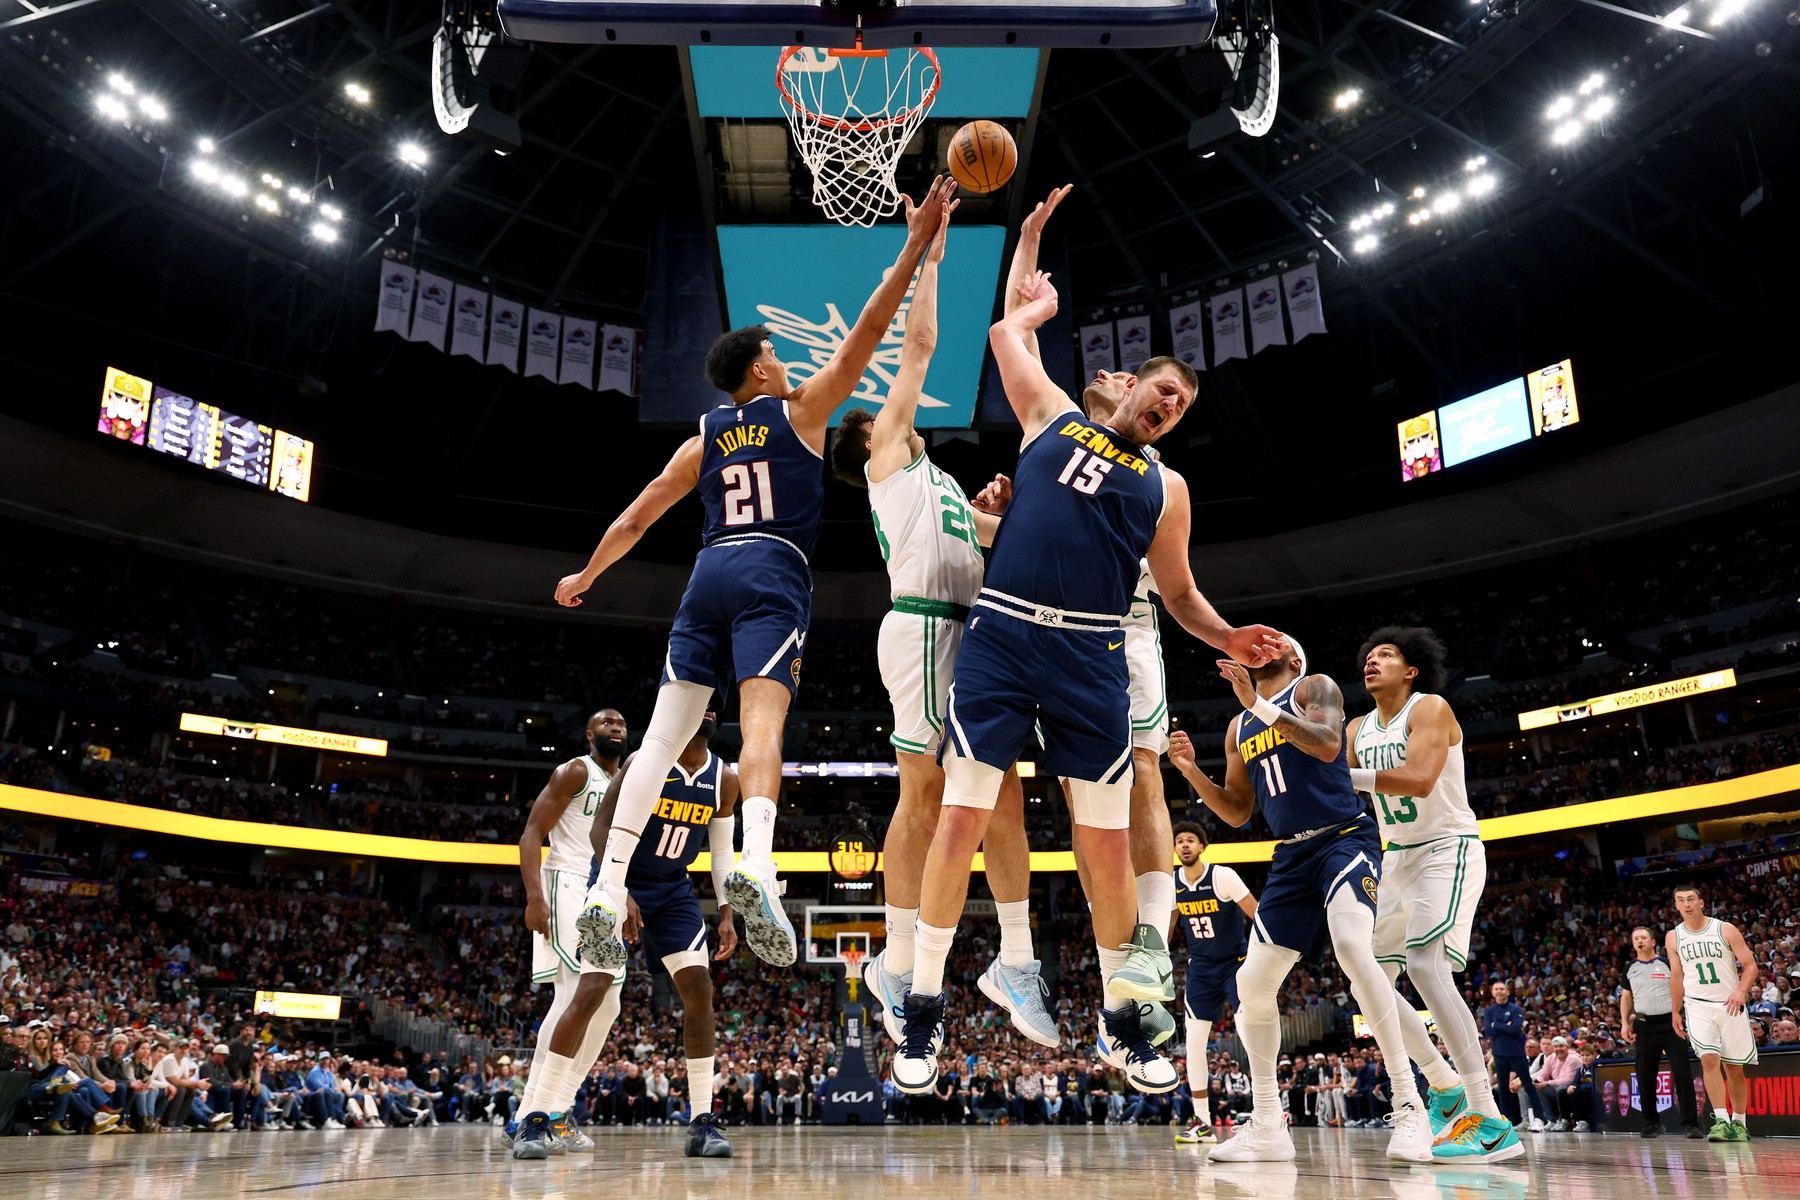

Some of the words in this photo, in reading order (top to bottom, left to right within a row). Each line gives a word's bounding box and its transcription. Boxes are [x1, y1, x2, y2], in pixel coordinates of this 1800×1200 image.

[715, 424, 769, 457] JONES
[1059, 420, 1149, 477] DENVER
[1057, 446, 1114, 496] 15
[721, 460, 775, 526] 21
[1614, 690, 1655, 706] VOODOO
[1658, 679, 1701, 698] RANGER
[1239, 726, 1287, 764] DENVE
[1259, 753, 1288, 797] 11
[1375, 793, 1418, 825] 13
[654, 823, 691, 860] 10
[1188, 916, 1215, 939] 23
[1680, 941, 1723, 962] CELTICS
[1695, 962, 1721, 985] 11
[1631, 1075, 1671, 1094] INDE
